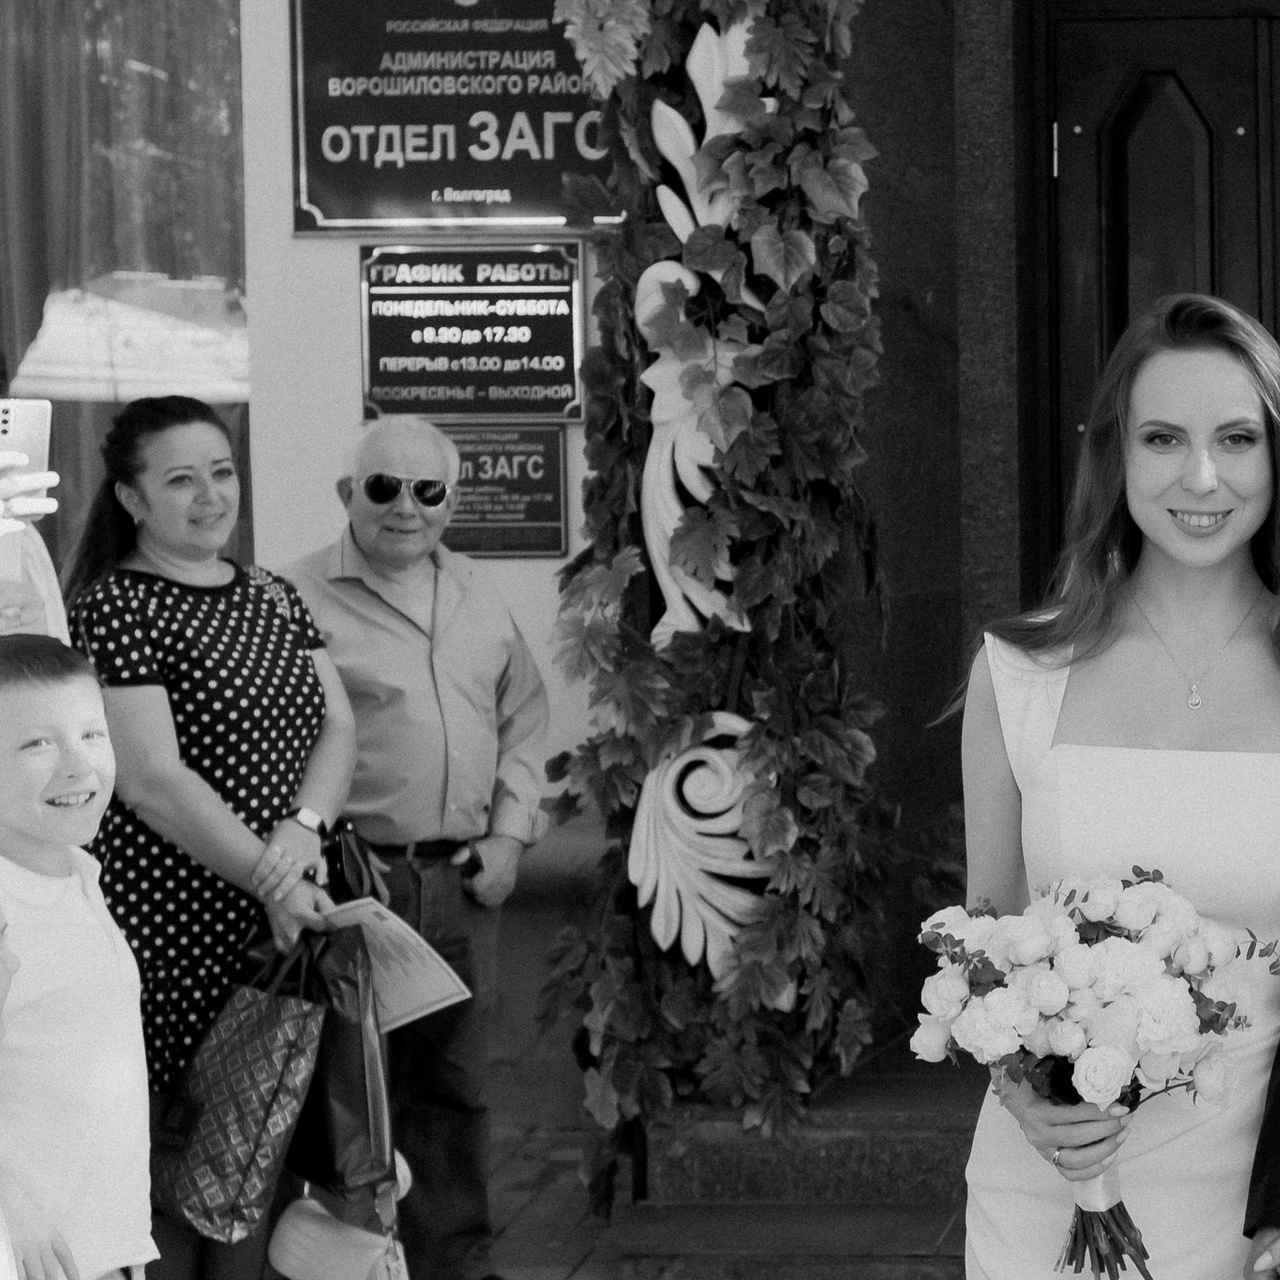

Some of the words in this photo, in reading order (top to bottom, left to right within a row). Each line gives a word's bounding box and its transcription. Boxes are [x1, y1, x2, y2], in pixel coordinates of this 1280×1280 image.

[379, 49, 557, 74] АДМИНИСТРАЦИЯ
[327, 74, 524, 97] ВОРОШИЛОВСКОГО
[526, 71, 596, 95] РАЙОН
[321, 124, 457, 169] ОТДЕЛ
[467, 109, 610, 161] ЗАГС
[369, 263, 465, 284] ГРАФИК
[476, 262, 570, 283] РАБОТЫ
[379, 356, 449, 372] ПЕРЕРЫВ
[371, 384, 476, 401] ВОСКРЕСЕНЬЕ
[488, 383, 573, 401] ВЫХОДНОЙ
[478, 454, 545, 480] ЗАГС
